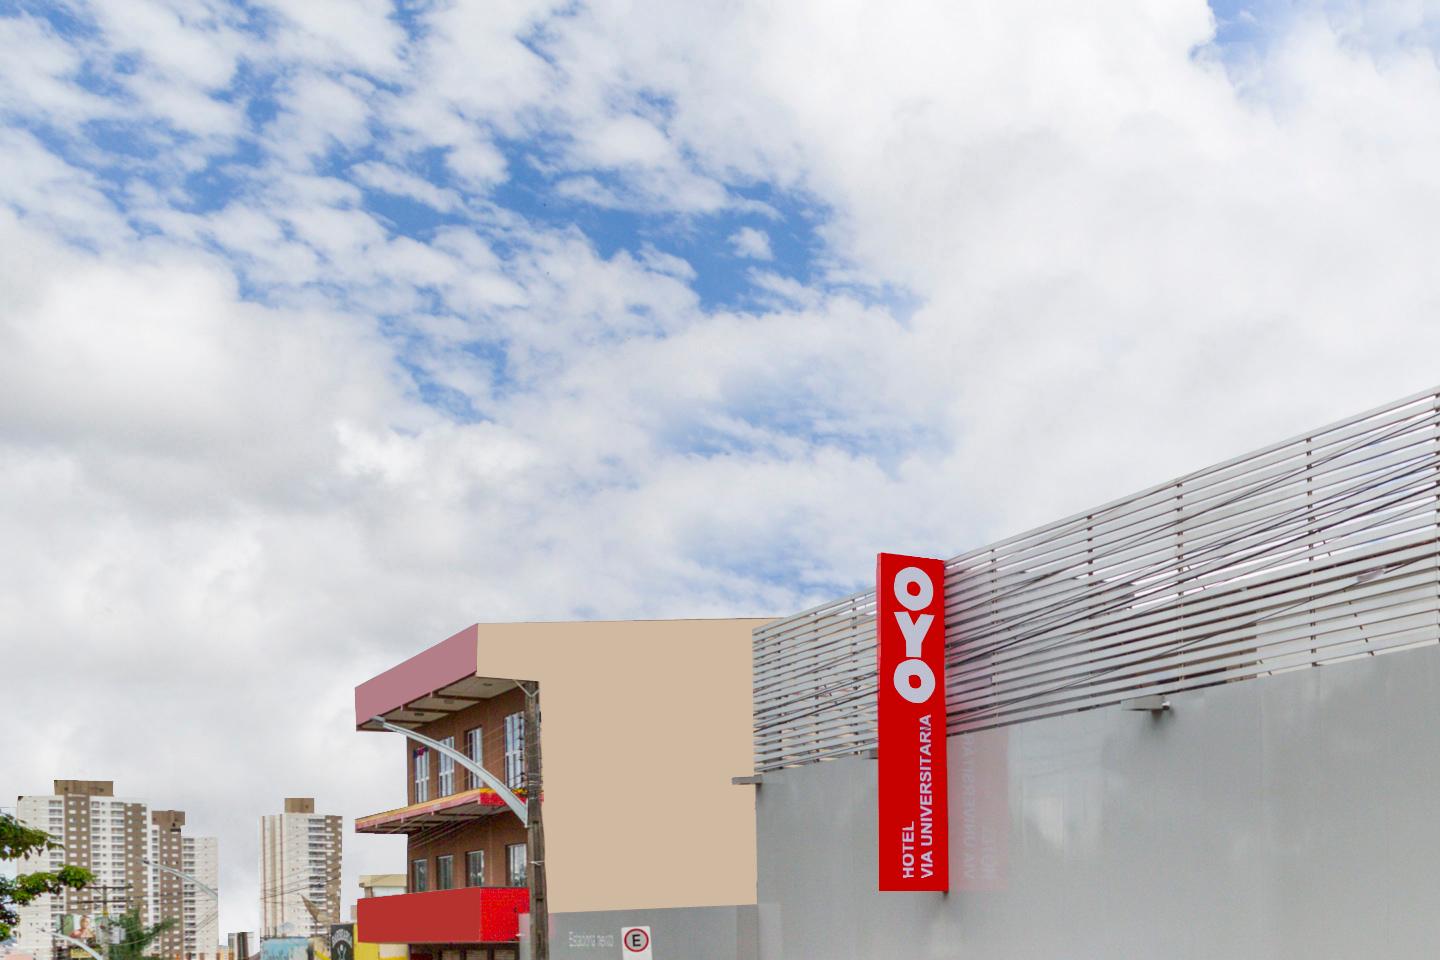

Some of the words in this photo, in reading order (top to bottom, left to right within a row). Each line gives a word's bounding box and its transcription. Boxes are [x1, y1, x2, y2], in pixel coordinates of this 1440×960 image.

[893, 566, 936, 704] OYO
[919, 713, 933, 847] UNIVERSITARIA
[902, 820, 915, 879] HOTEL
[920, 850, 933, 879] VIA
[632, 934, 642, 947] E
